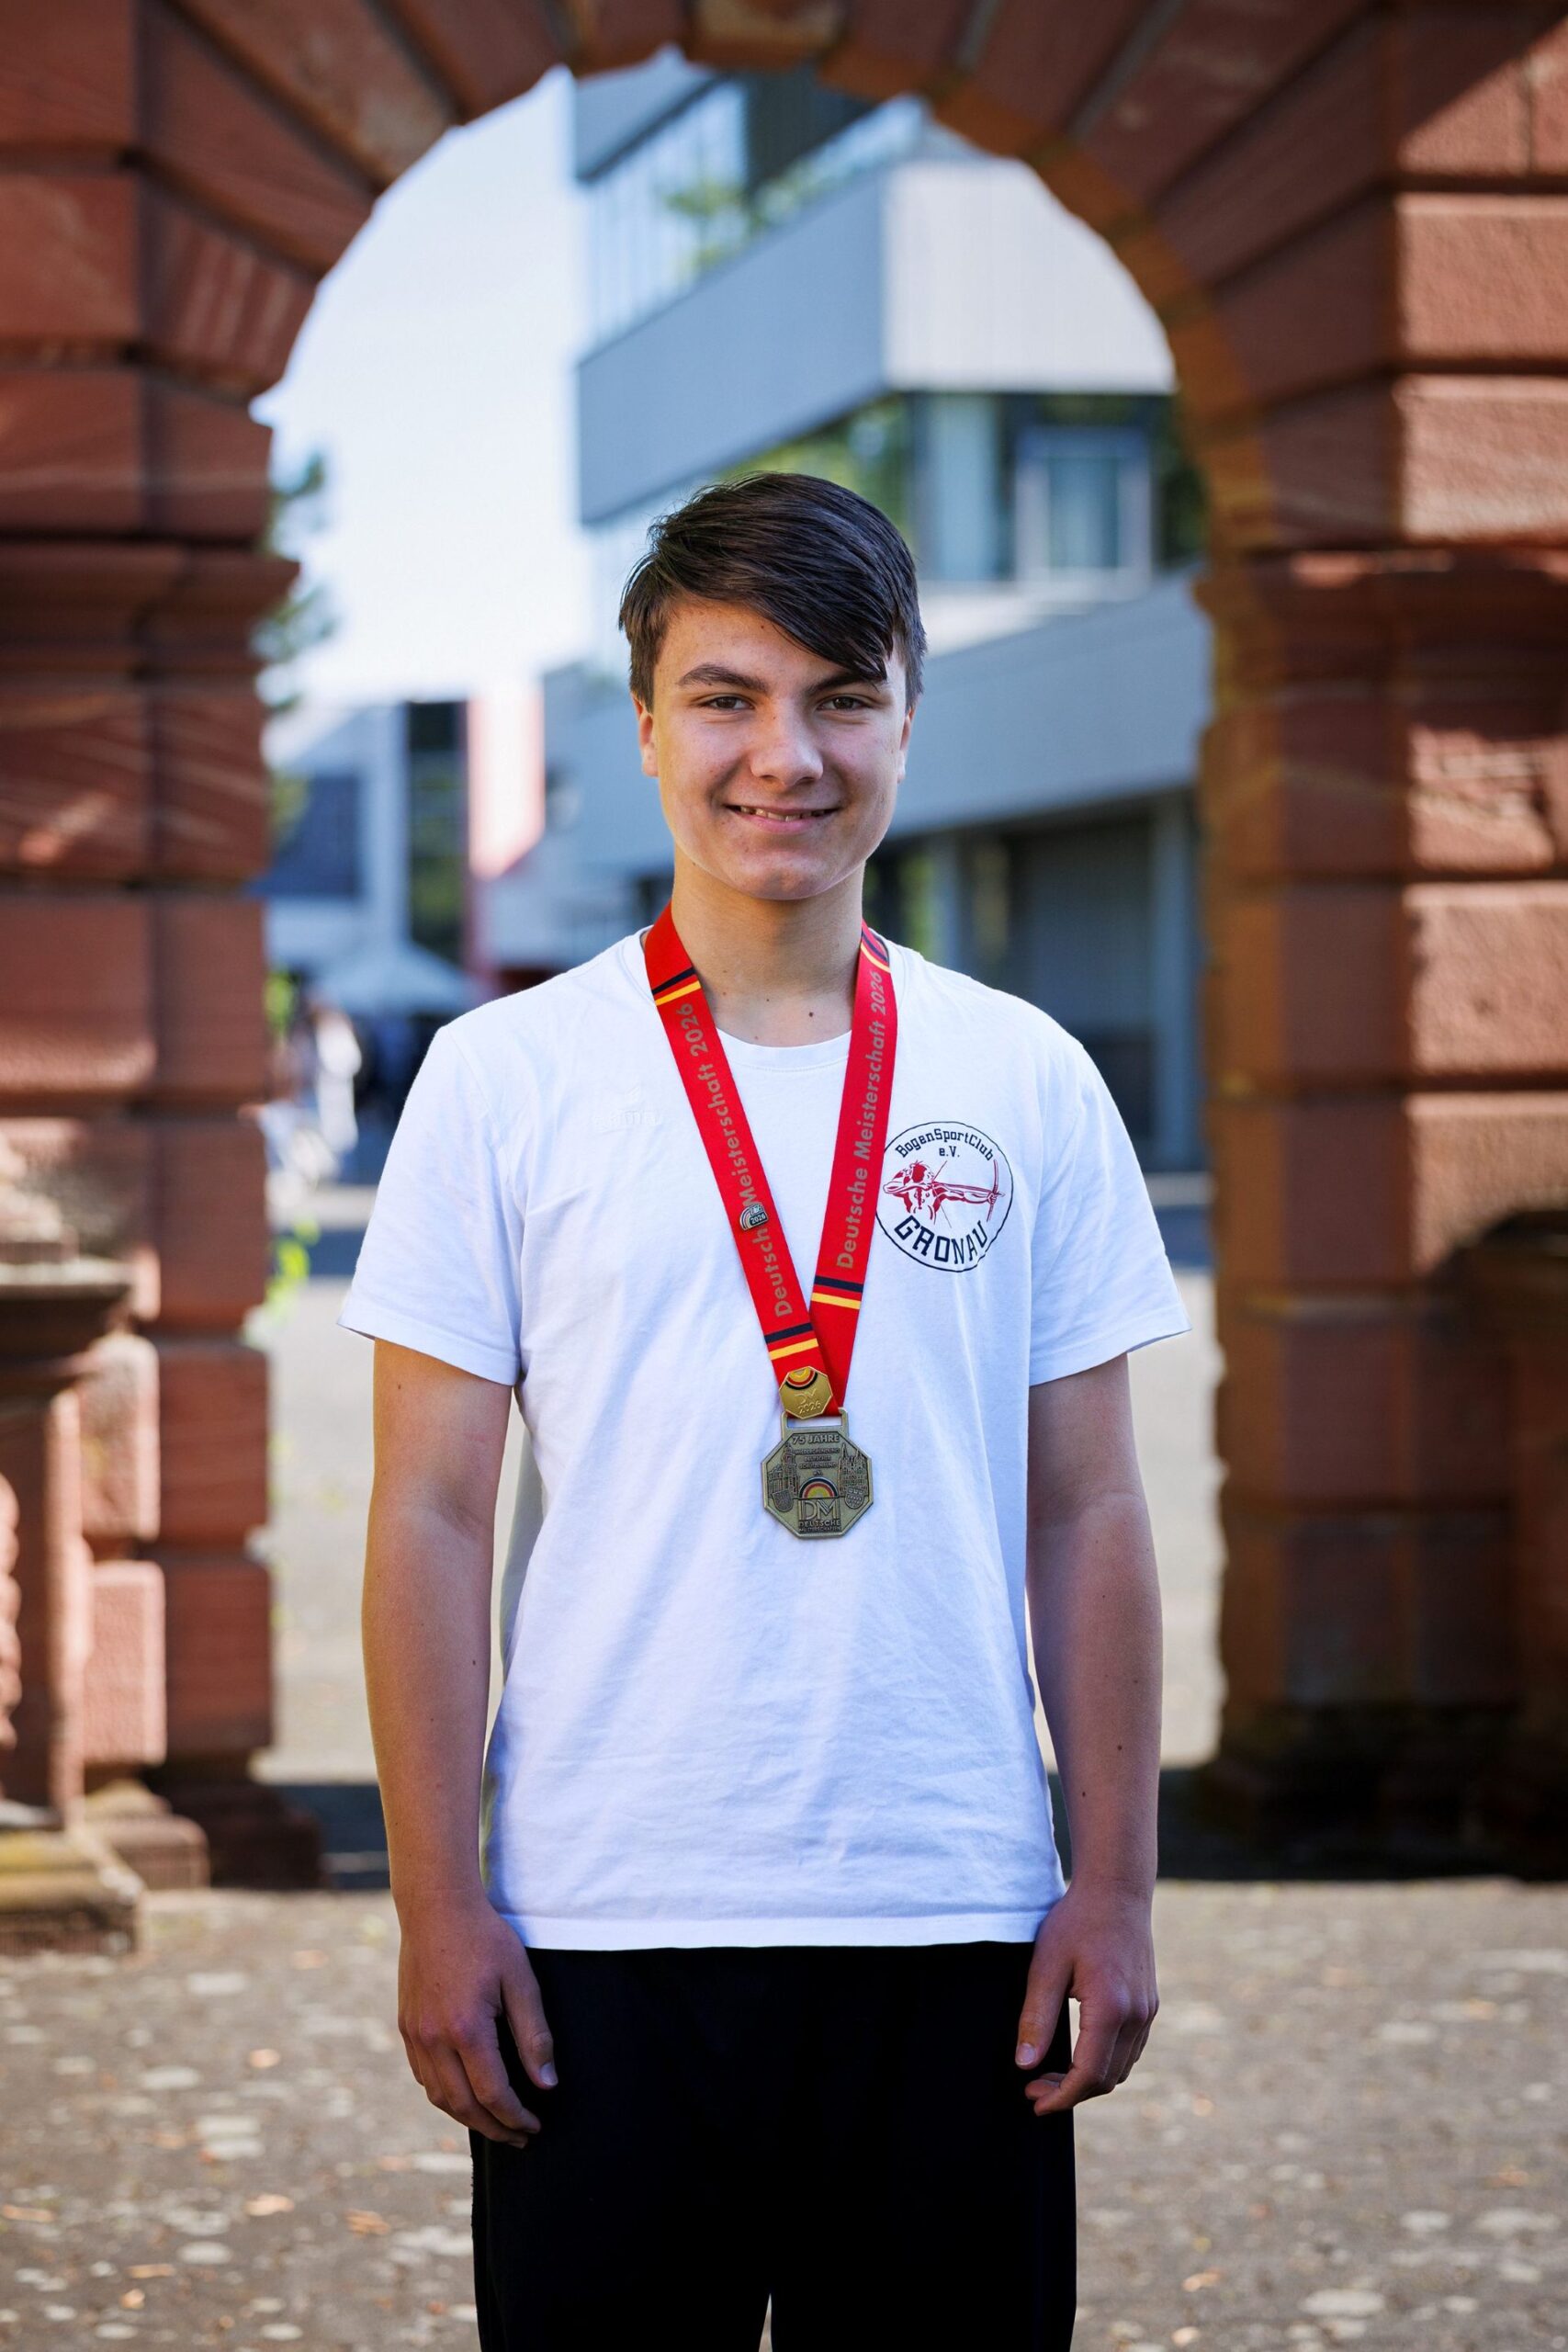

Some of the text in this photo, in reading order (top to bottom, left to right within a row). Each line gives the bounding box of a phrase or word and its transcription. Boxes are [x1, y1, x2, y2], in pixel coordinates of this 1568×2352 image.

[836, 971, 892, 1270] Deutsche Meisterschaft 2026
[895, 1128, 994, 1162] BogenSportClub
[939, 1146, 960, 1158] e.V.
[675, 1002, 793, 1317] Deutsch Meisterschaft 2026
[750, 1214, 766, 1224] 2026
[894, 1215, 988, 1265] GRONAU
[797, 1399, 822, 1415] 2026
[792, 1433, 840, 1444] 75 JAHRE
